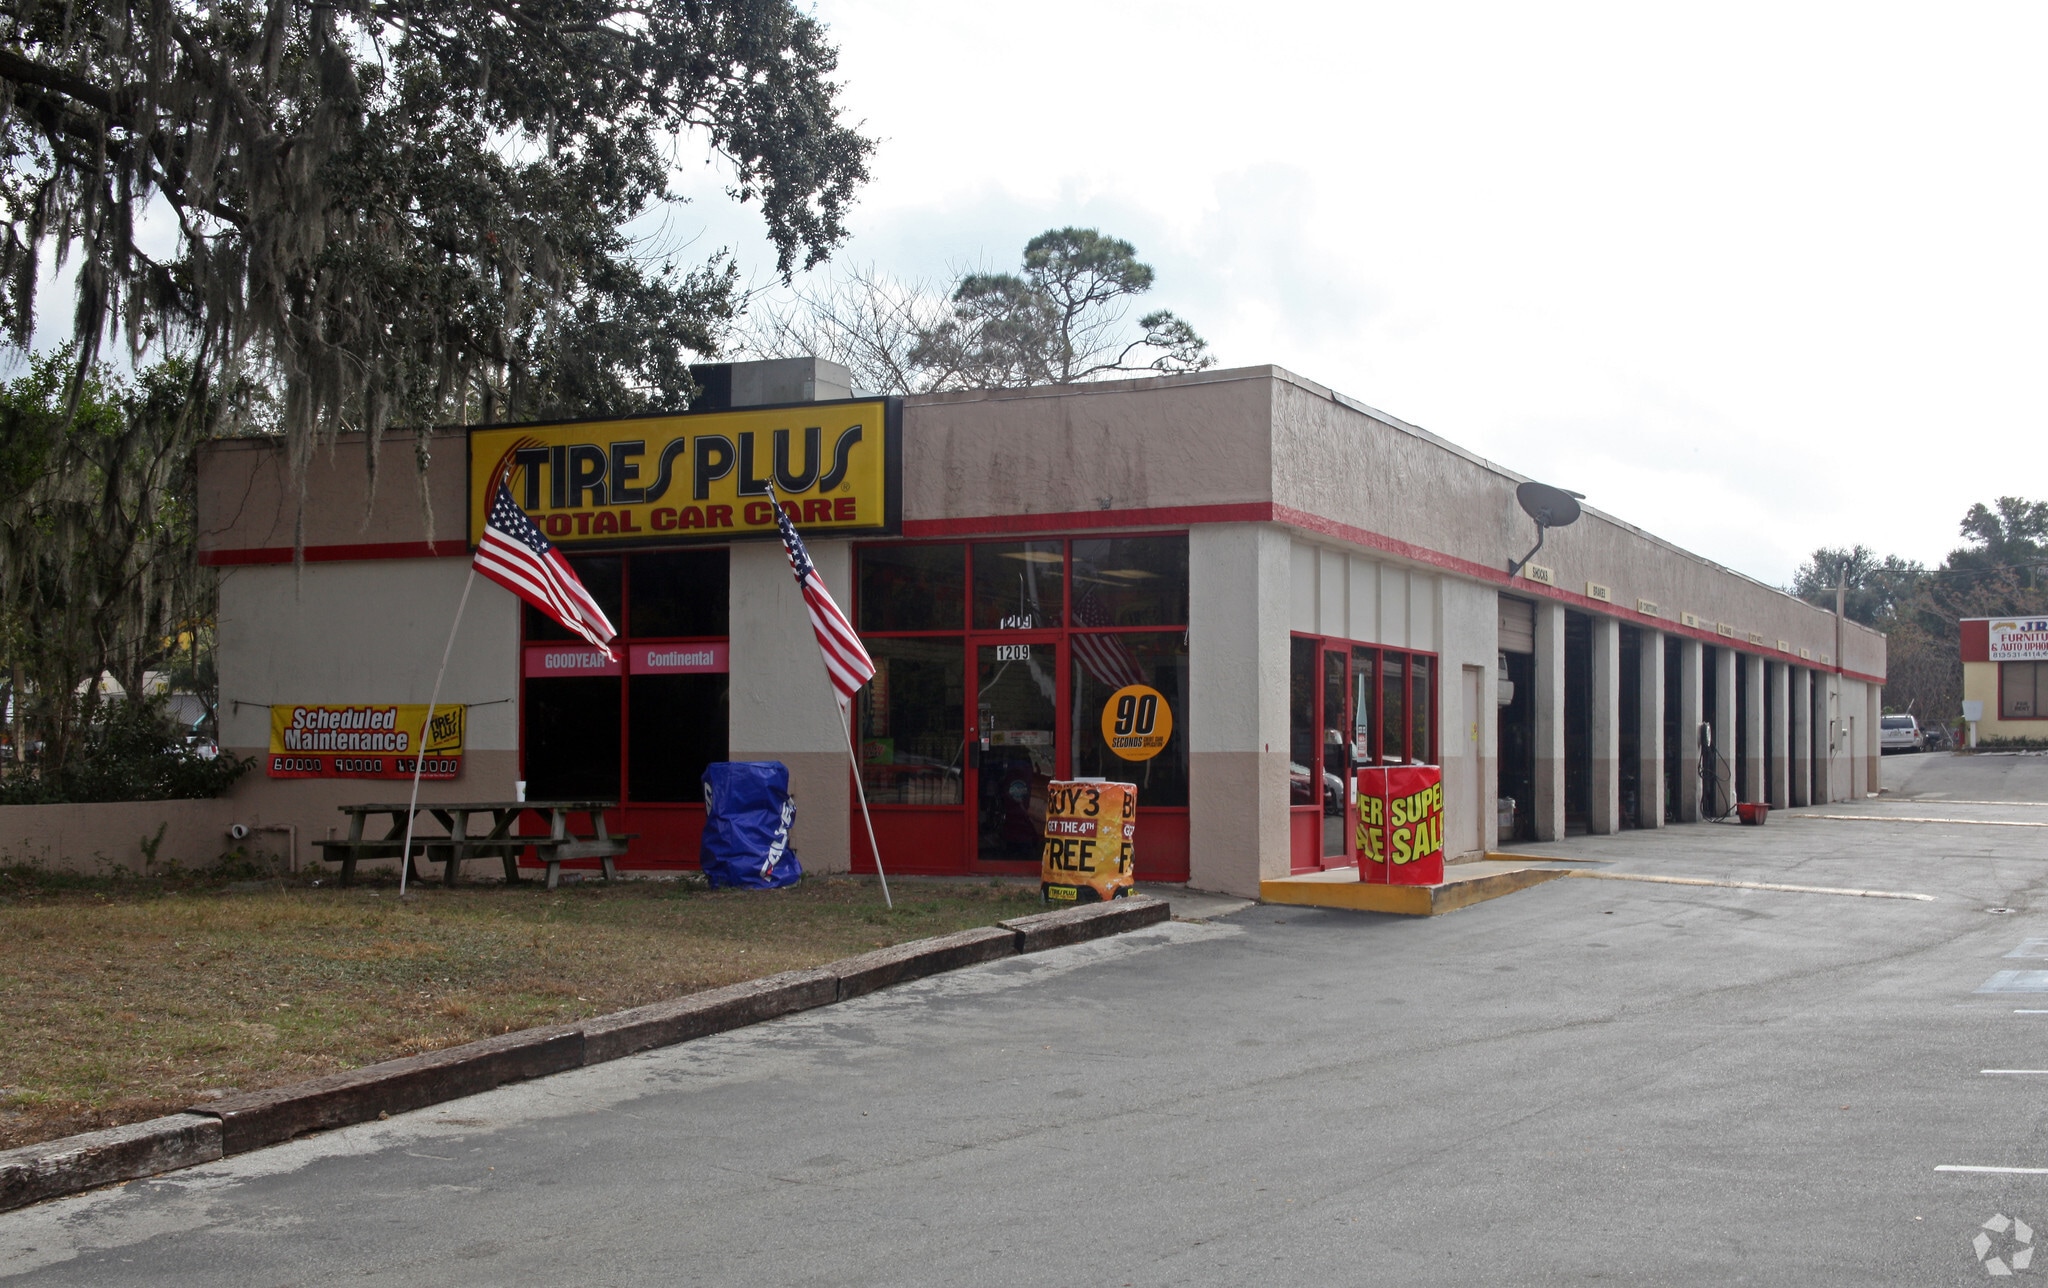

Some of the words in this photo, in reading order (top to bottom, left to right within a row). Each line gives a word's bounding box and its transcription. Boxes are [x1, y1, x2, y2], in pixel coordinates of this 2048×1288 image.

[650, 503, 734, 531] CAR
[744, 496, 856, 526] CARE
[998, 645, 1029, 660] 1209
[1991, 643, 1998, 651] &
[2000, 642, 2023, 652] AUTO
[545, 653, 605, 668] GOODYEAR
[647, 650, 714, 667] Continental
[292, 708, 396, 730] Scheduled
[1114, 694, 1158, 736] 90
[284, 729, 408, 751] Maintenance
[1112, 736, 1143, 748] SECONDS
[273, 758, 322, 772] 60000
[335, 758, 382, 772] 90000
[1048, 787, 1082, 815] BUY
[1083, 788, 1100, 817] 3
[1391, 781, 1444, 827] SUPE
[1047, 820, 1058, 833] GET
[1060, 821, 1078, 833] THE
[1078, 821, 1095, 834] 4TH
